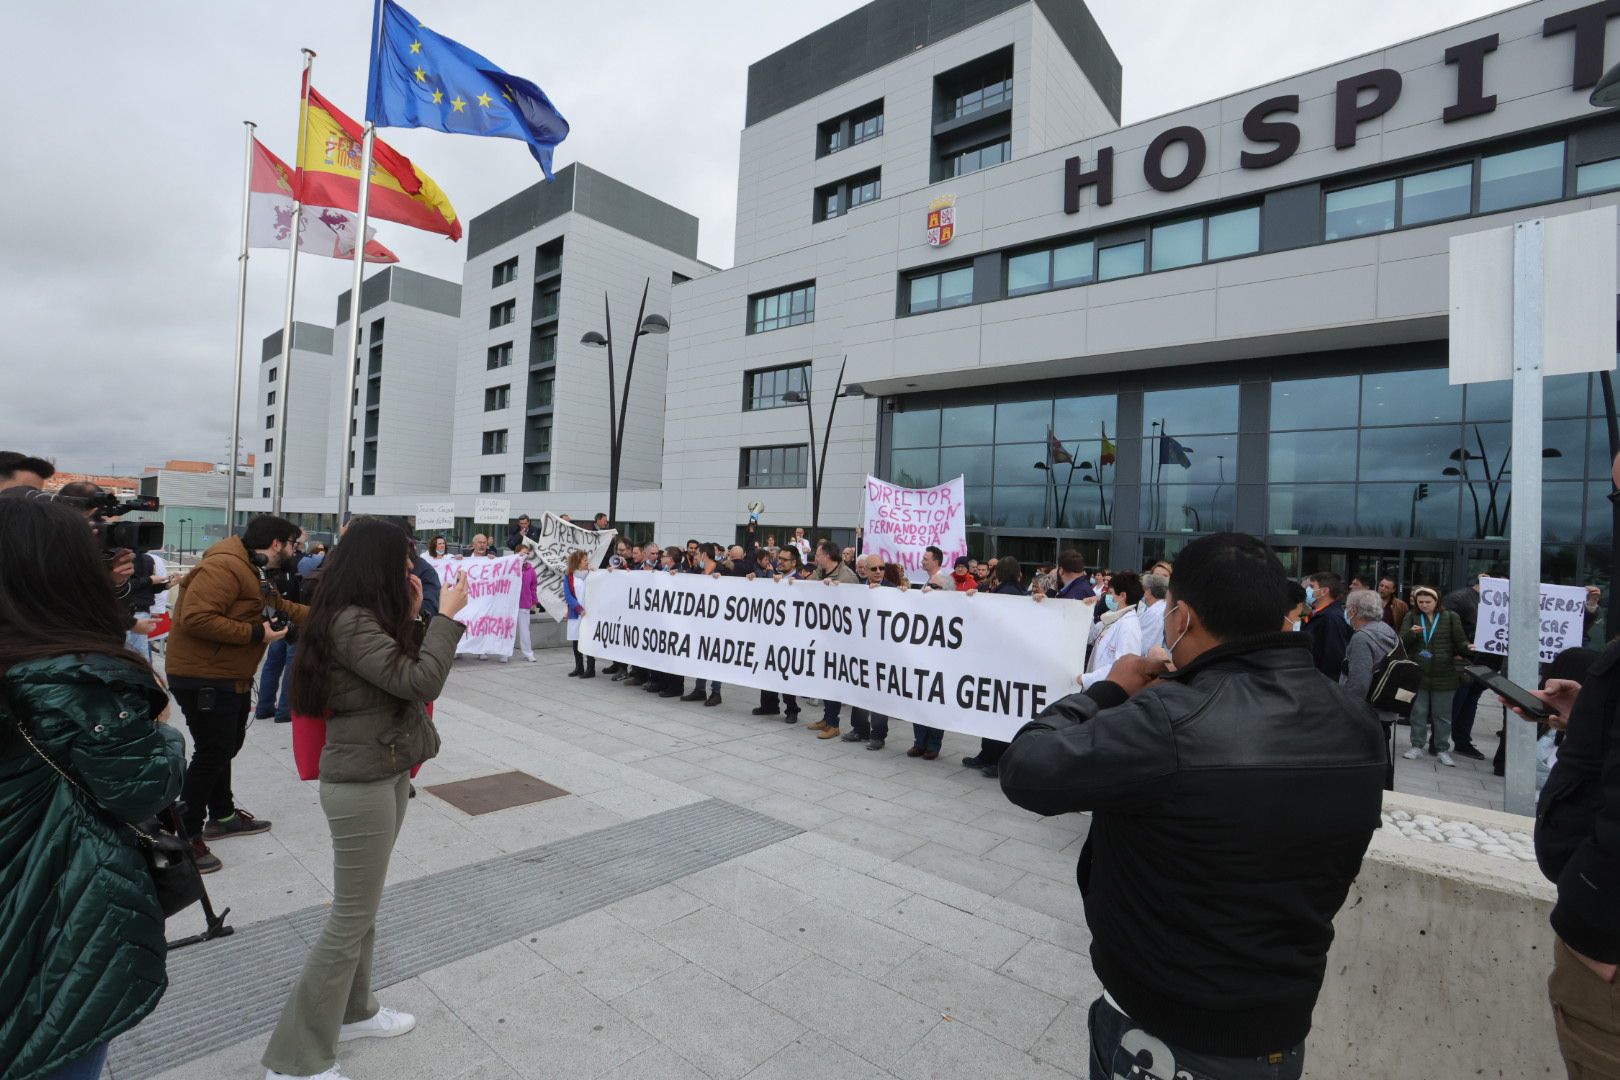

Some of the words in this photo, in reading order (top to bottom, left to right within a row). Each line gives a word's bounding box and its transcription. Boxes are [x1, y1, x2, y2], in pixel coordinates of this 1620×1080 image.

[1064, 3, 1620, 214] HOSPIT
[868, 481, 952, 507] DIRECTOR
[878, 501, 962, 524] GESTION
[869, 519, 927, 536] FERNANDO
[894, 533, 941, 547] IGLESIA
[628, 587, 641, 610] LA
[644, 588, 719, 619] SANIDAD
[724, 595, 786, 626] SOMOS
[792, 600, 851, 635] TODOS
[858, 607, 871, 638] Y
[877, 610, 964, 649] TODAS
[593, 616, 622, 648] AQUÍ
[623, 625, 639, 649] NO
[642, 627, 691, 658] SOBRA
[697, 635, 759, 674] NADIE,
[764, 640, 816, 680] AQUÍ
[824, 651, 869, 688] HACE
[876, 662, 945, 705] FALTA
[956, 674, 1047, 719] GENTE
